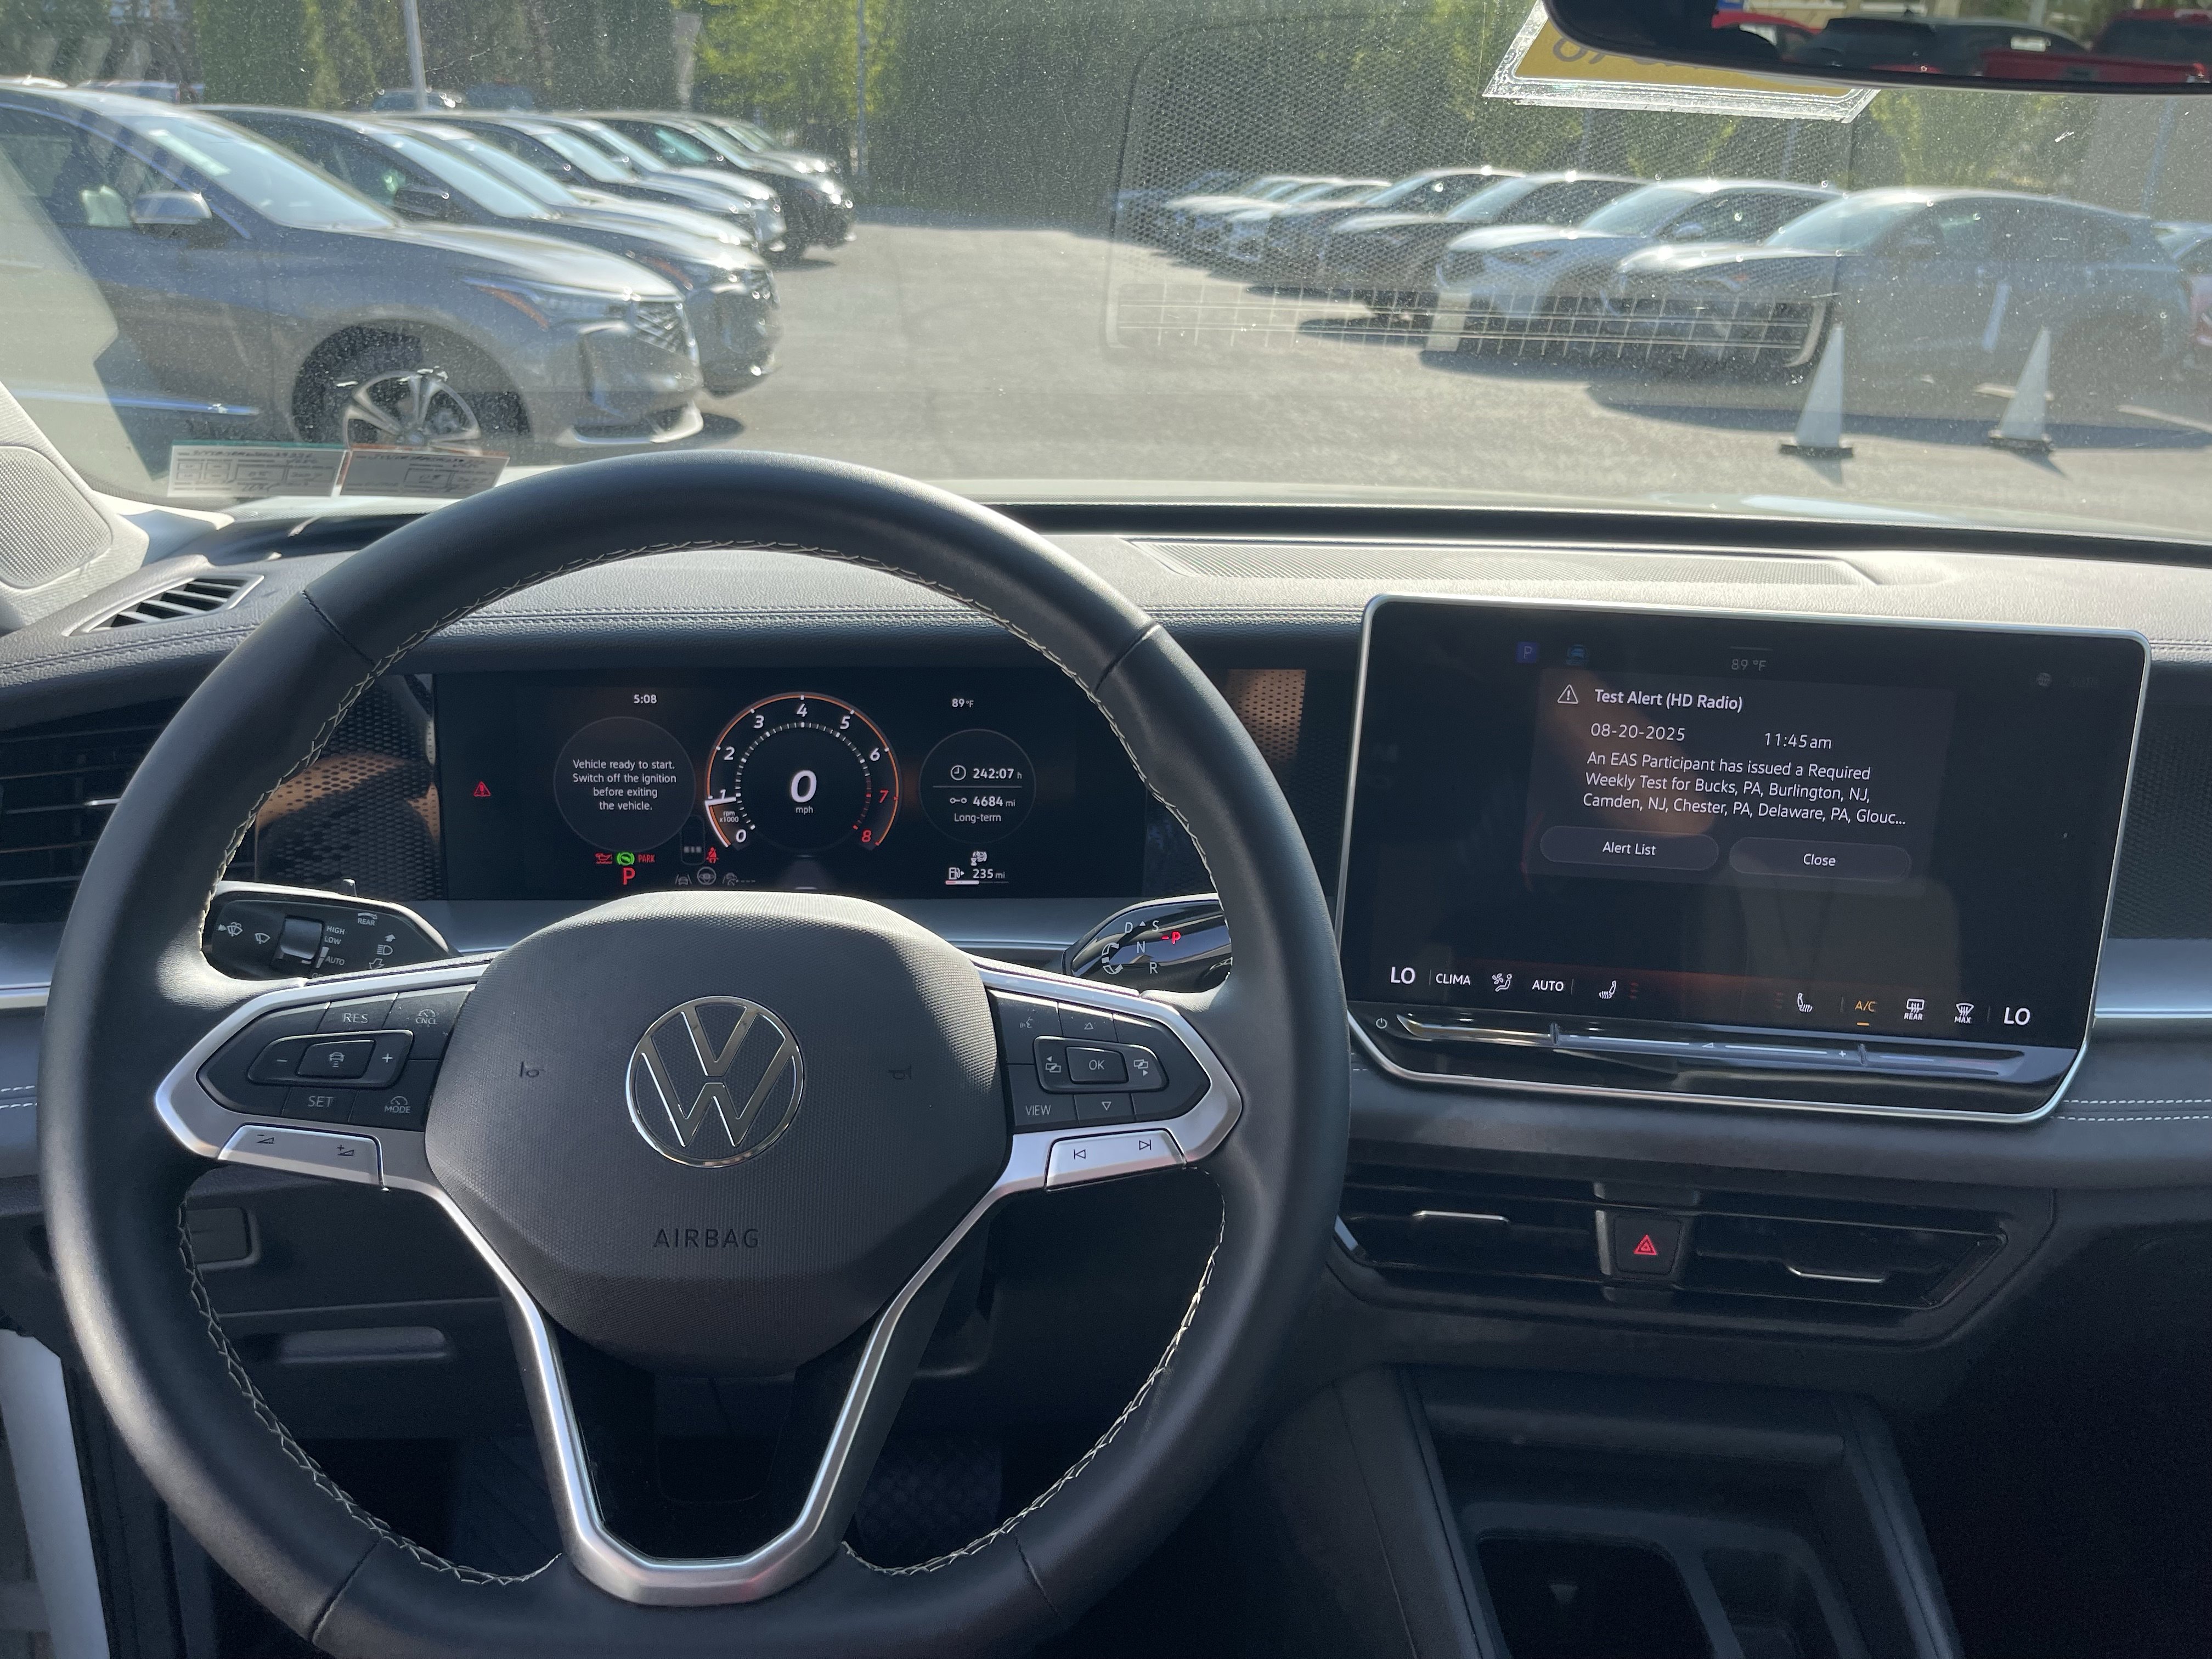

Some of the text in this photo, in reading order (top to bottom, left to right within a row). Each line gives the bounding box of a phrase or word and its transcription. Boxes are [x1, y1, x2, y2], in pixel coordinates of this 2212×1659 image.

[1731, 659, 1748, 670] 89
[633, 694, 657, 704] 5:08
[1595, 689, 1742, 713] Test Alert (HD Radio)
[797, 703, 808, 717] 4
[753, 715, 765, 729] 3
[840, 715, 850, 729] 5
[1591, 723, 1685, 741] 08-20-2025
[724, 746, 735, 760] 2
[870, 748, 881, 761] 6
[573, 759, 675, 771] Vehicle ready to start.
[1587, 751, 1871, 781] An EAS Participant has issued a Required
[573, 773, 676, 785] Switch off the ignition
[973, 768, 1022, 780] 242:07 h
[791, 770, 817, 803] 0
[1585, 772, 1870, 804] Weekly Test for Bucks, PA, Burlington, NJ,
[593, 787, 658, 799] before exiting
[720, 789, 726, 799] 1
[879, 789, 889, 803] 7
[599, 800, 652, 810] the vehicle.
[973, 796, 1003, 807] 4684
[795, 805, 814, 815] mph
[1583, 793, 1906, 825] Camden, NJ, Chester, PA, Delaware, PA, Glouc...
[954, 813, 1001, 823] Long-term
[736, 829, 747, 843] 0
[861, 830, 872, 843] 8
[1602, 841, 1656, 857] Alert List
[638, 854, 655, 863] PARK
[1803, 853, 1836, 867] Close
[623, 867, 635, 885] P
[973, 868, 1005, 879] 235 mi
[358, 918, 375, 926] REAR
[1124, 922, 1133, 934] D
[1152, 920, 1159, 932] S
[326, 926, 346, 935] HIGH
[324, 936, 342, 945] LOW
[1171, 931, 1181, 944] P
[1136, 941, 1146, 953] N
[325, 956, 345, 966] AUTO
[1149, 962, 1159, 974] R
[1390, 966, 1416, 984] LO
[1436, 973, 1471, 985] CLIMA
[1532, 979, 1564, 992] AUTO
[1854, 1000, 1877, 1013] A/C
[343, 1012, 369, 1023] RES
[1904, 1012, 1923, 1020] REAR
[1954, 1016, 1972, 1024] MAX
[2004, 1007, 2030, 1025] LO
[1088, 1059, 1105, 1070] OK
[308, 1096, 334, 1108] SET
[384, 1105, 411, 1114] MODE
[1025, 1104, 1051, 1116] VIEW
[653, 1228, 759, 1249] AIRBAG
